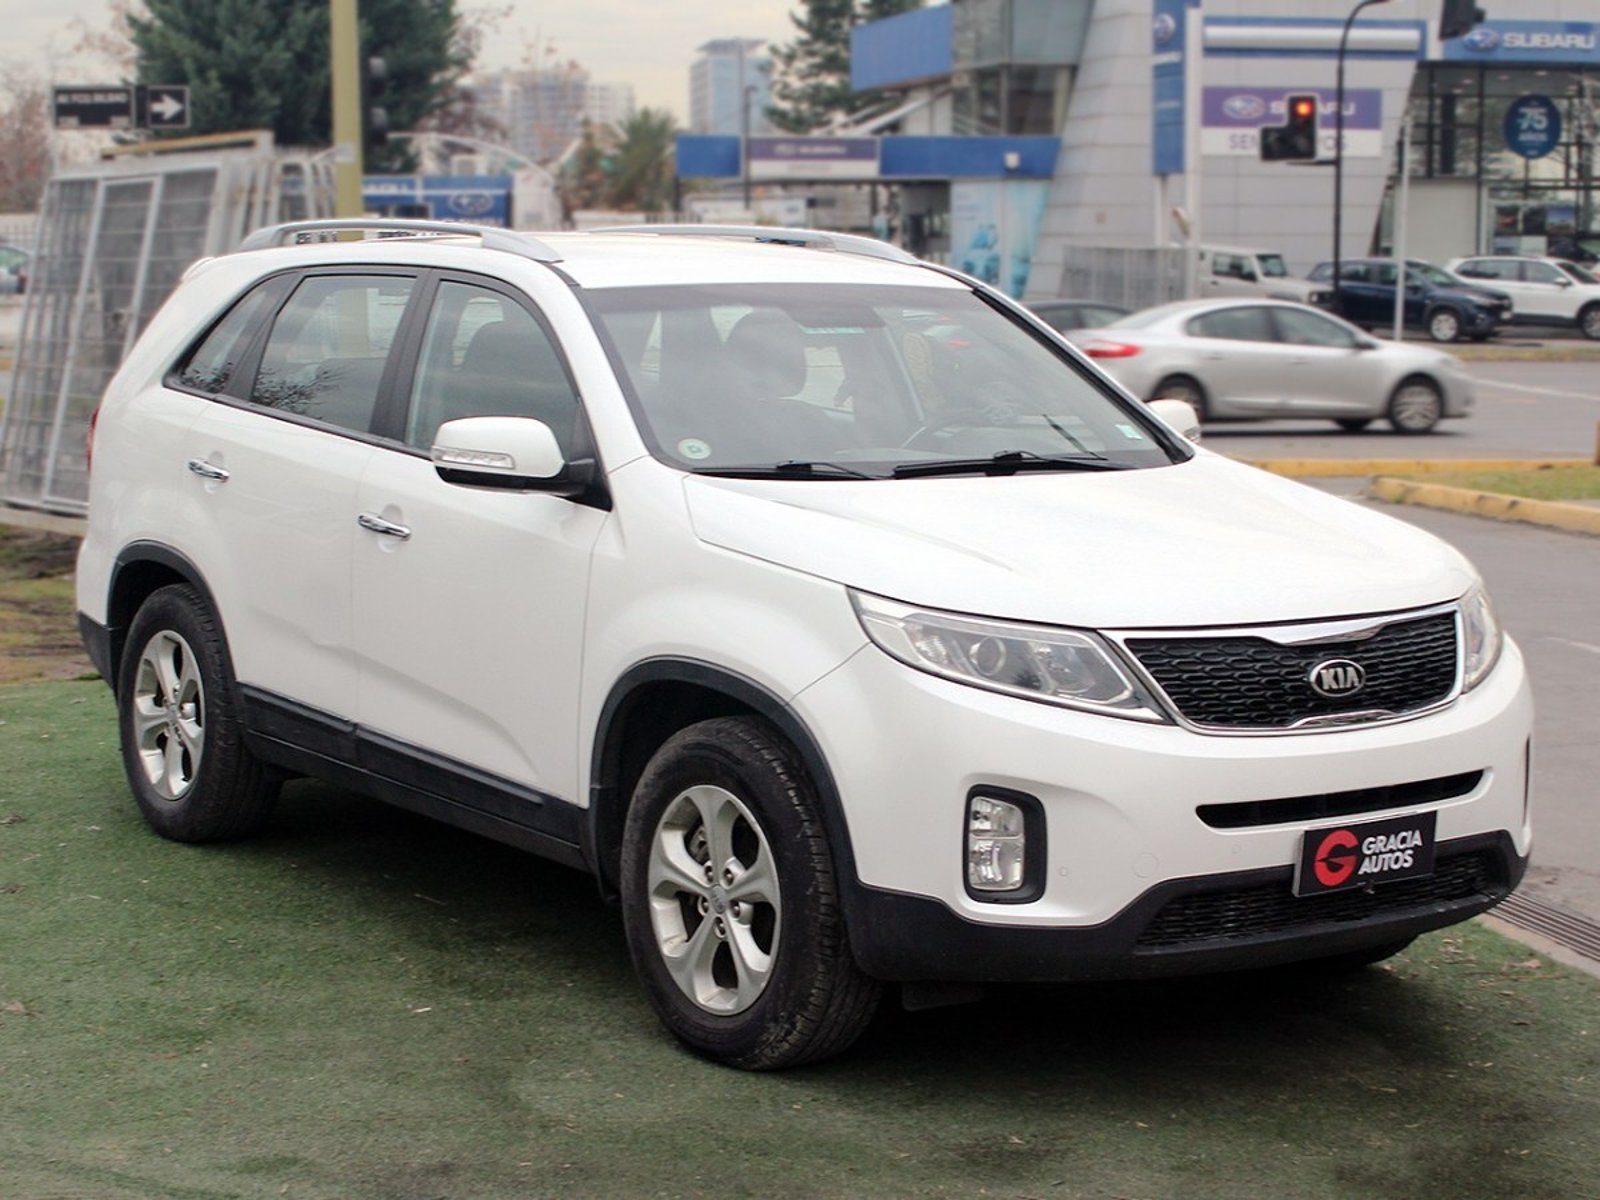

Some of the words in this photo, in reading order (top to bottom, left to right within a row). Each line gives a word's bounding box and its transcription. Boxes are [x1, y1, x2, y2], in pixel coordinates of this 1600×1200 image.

[1503, 32, 1596, 49] SUBARU
[1269, 101, 1356, 116] SARU
[1519, 107, 1549, 130] 75
[1320, 666, 1360, 690] KIA
[1361, 829, 1423, 855] GRACIA
[1358, 849, 1414, 875] AUTOS
